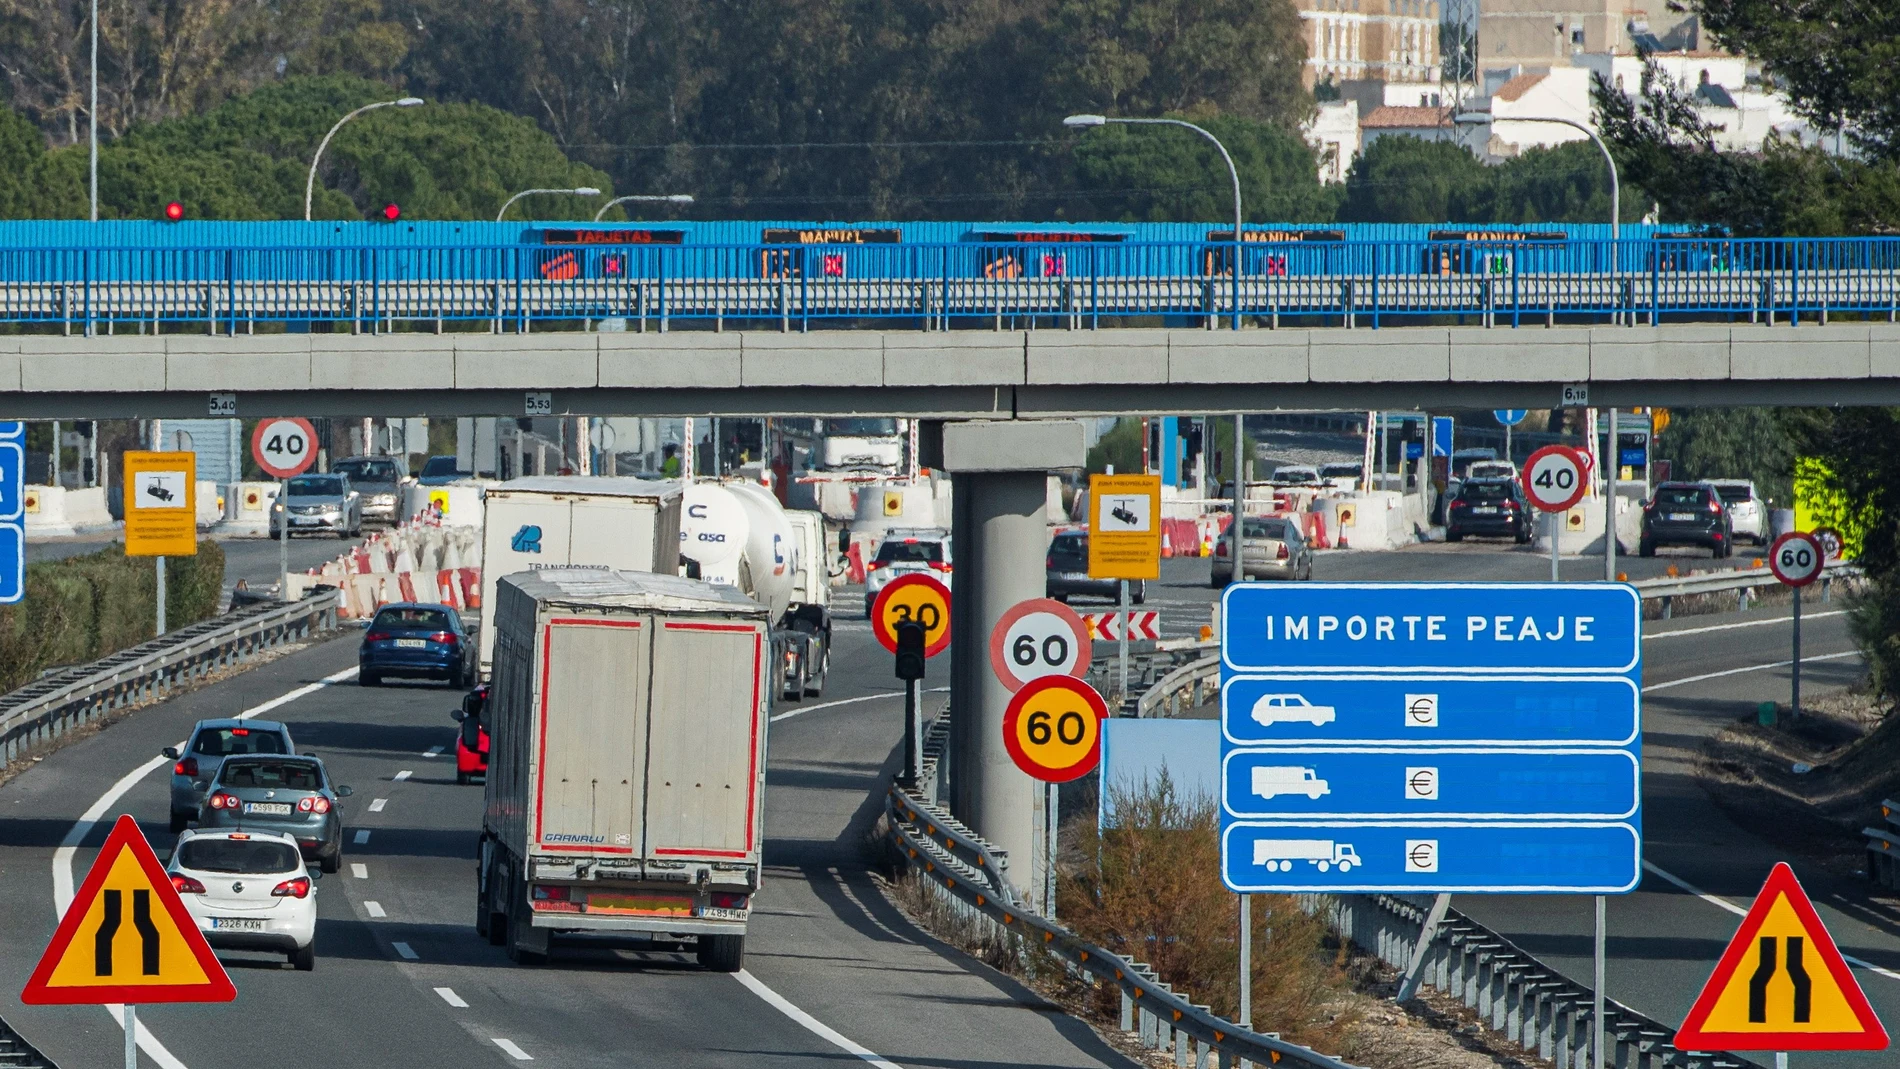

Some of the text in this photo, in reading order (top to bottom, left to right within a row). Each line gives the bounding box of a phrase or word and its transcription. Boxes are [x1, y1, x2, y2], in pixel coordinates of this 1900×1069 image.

[210, 397, 236, 410] 5,40
[526, 397, 550, 410] 5,53
[266, 434, 304, 455] 40
[1535, 468, 1574, 489] 40
[1781, 549, 1811, 568] 60
[891, 603, 940, 631] 30
[1266, 615, 1596, 642] IMPORTE PEAJE
[1013, 635, 1068, 666] 60
[1027, 711, 1085, 745] 60
[544, 833, 605, 843] GRANALU
